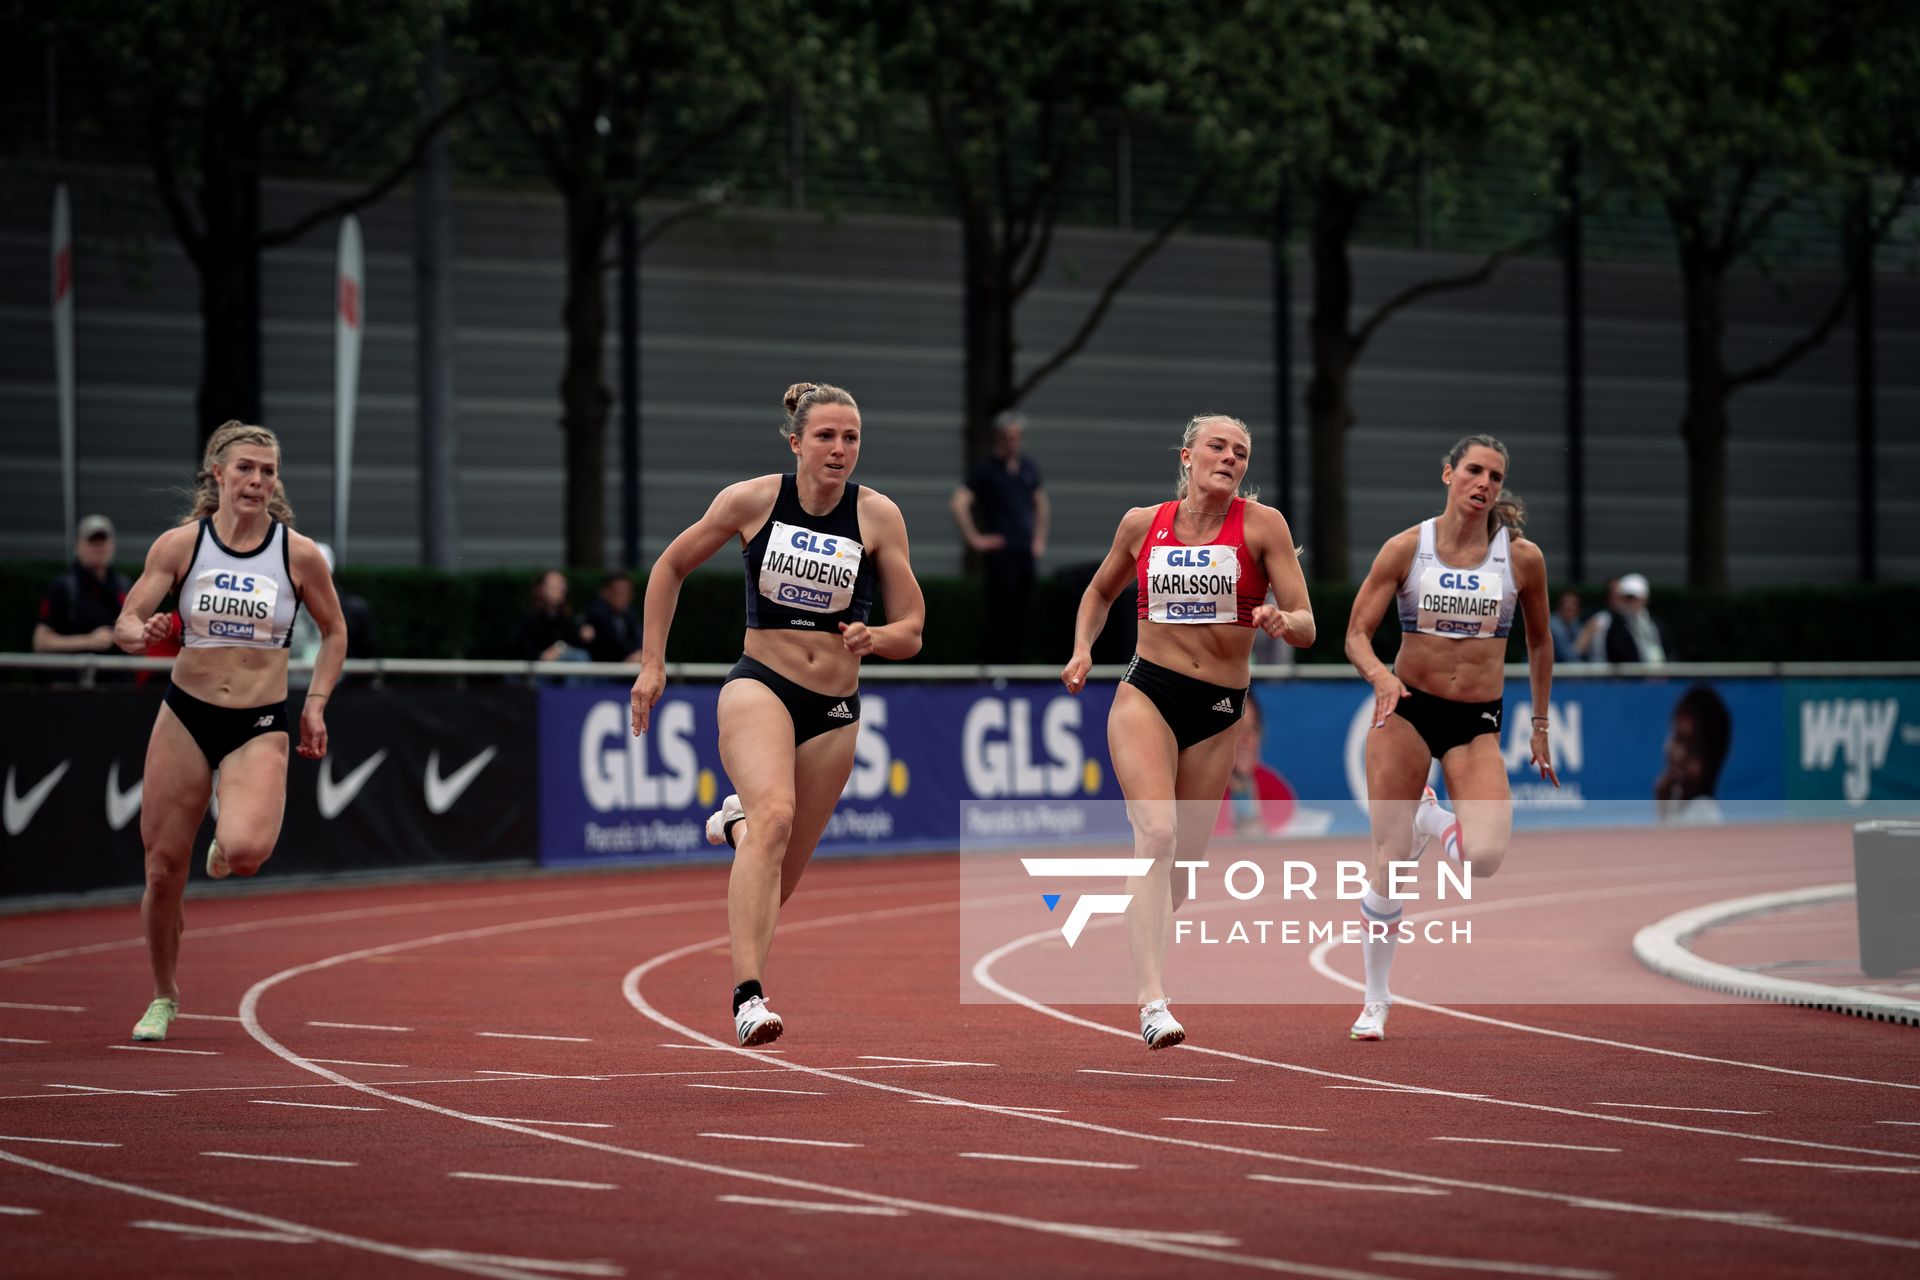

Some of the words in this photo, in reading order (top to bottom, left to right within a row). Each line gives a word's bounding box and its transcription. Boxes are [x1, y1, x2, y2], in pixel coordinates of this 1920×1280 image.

[767, 550, 853, 589] MAUDENS
[1152, 573, 1233, 595] KARLSSON
[800, 590, 830, 603] PLAN
[198, 594, 268, 620] BURNS
[1187, 605, 1214, 614] PLAN
[1423, 594, 1498, 617] OBERMAIER
[791, 618, 816, 627] adidas
[1455, 623, 1480, 631] PLAN
[227, 624, 253, 635] PLAN
[827, 710, 853, 720] adidas
[1212, 705, 1234, 714] adidas
